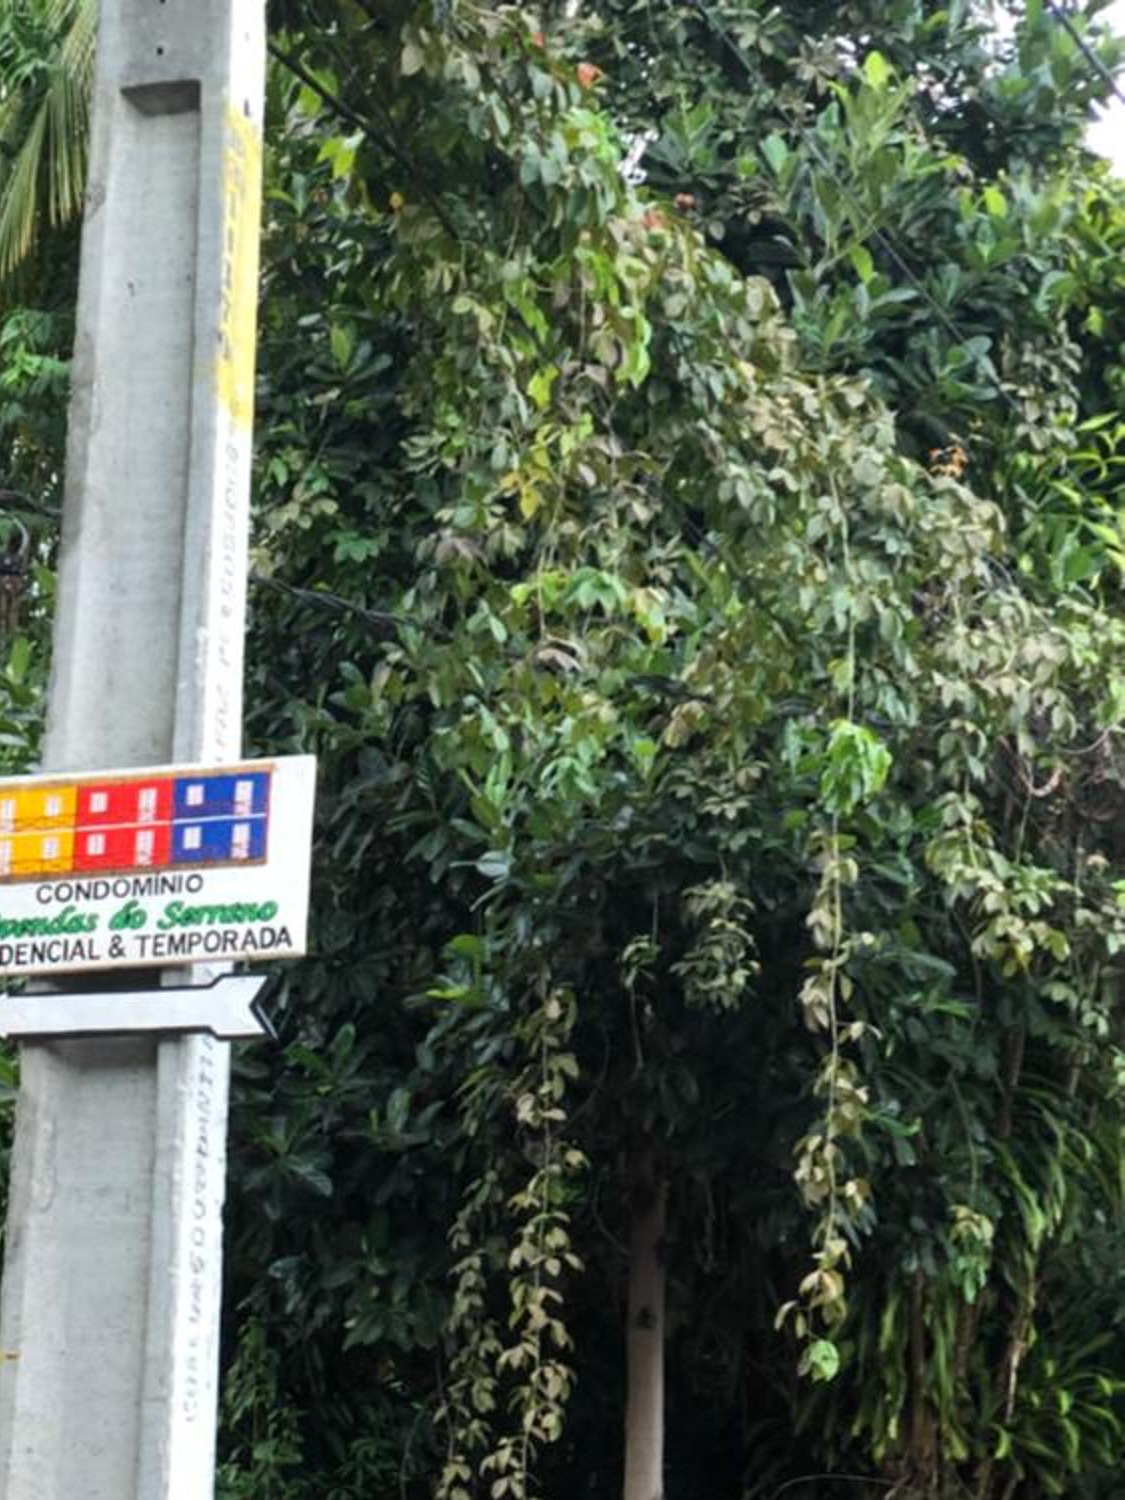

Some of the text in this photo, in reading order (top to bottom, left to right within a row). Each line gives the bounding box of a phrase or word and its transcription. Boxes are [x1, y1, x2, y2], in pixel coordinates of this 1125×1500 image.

[109, 900, 148, 931] do
[156, 900, 279, 930] Serrano
[108, 934, 126, 959] &
[135, 926, 292, 958] TEMPORADA
